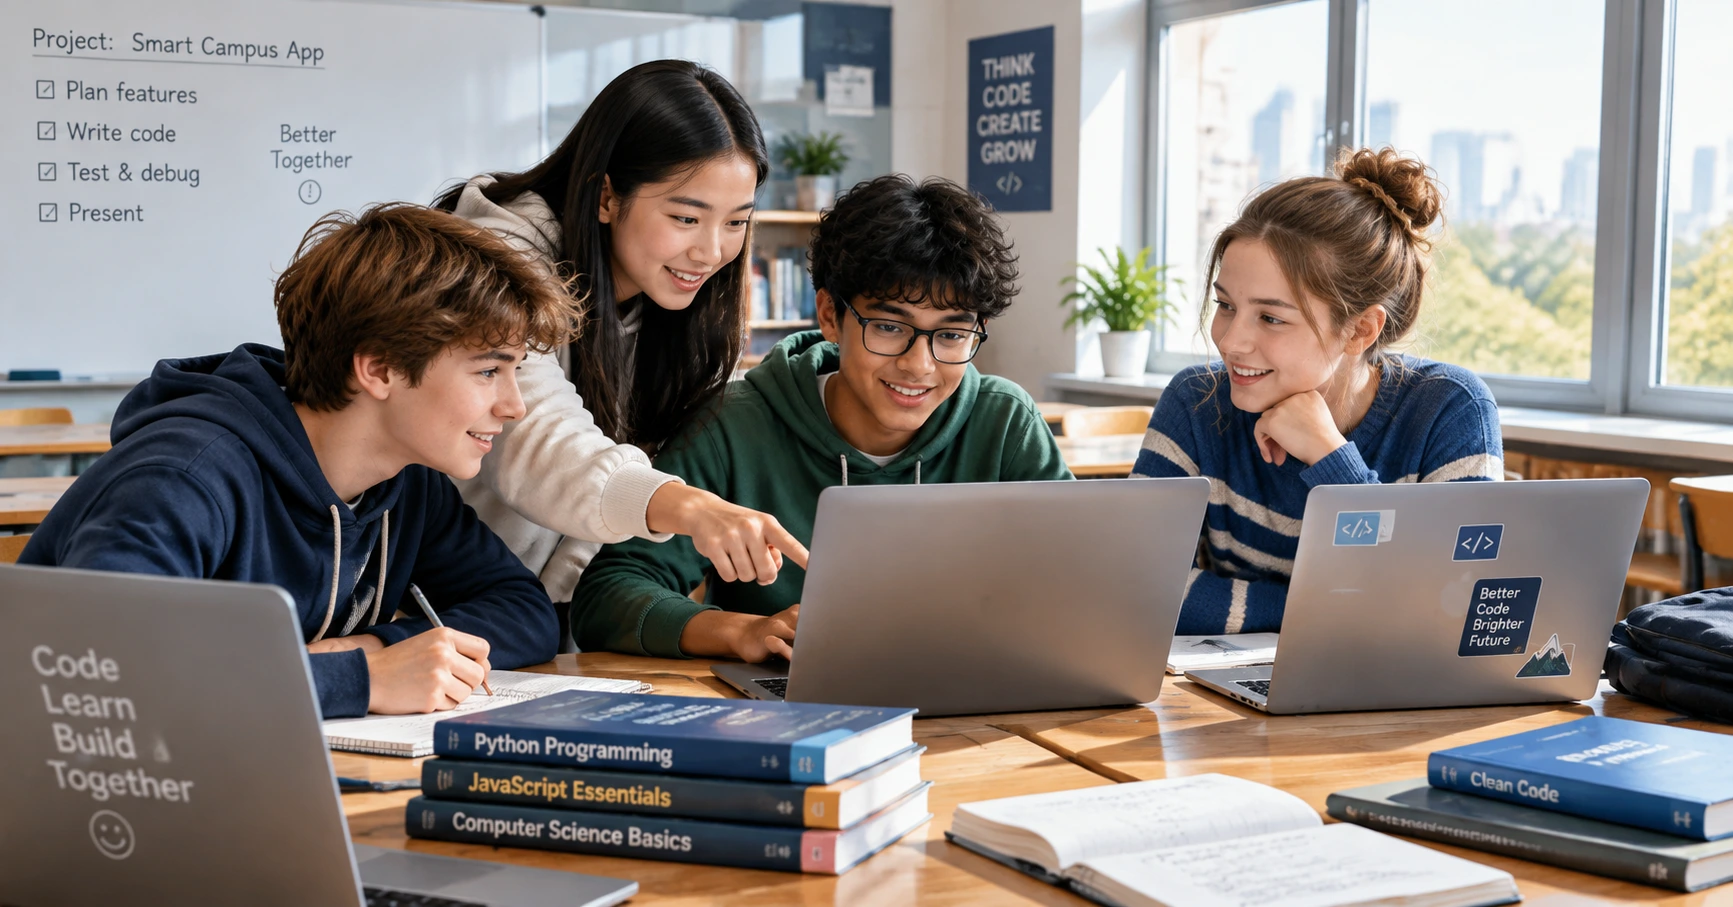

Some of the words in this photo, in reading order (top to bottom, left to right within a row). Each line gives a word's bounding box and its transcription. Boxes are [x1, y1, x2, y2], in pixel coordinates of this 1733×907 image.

[33, 28, 113, 54] Project:
[132, 32, 193, 54] Smart
[202, 37, 278, 63] Campus
[286, 41, 324, 66] App
[982, 52, 1035, 80] THINK
[67, 80, 108, 101] Plan
[117, 82, 197, 103] features
[982, 81, 1032, 109] CODE
[67, 122, 122, 141] Write
[130, 124, 176, 142] code
[280, 124, 336, 143] Better
[976, 109, 1042, 137] CREATE
[270, 149, 353, 174] Together
[981, 139, 1036, 165] GROW
[67, 162, 110, 181] Test
[118, 163, 132, 181] &
[141, 163, 200, 188] debug
[70, 203, 144, 222] Present
[1480, 587, 1520, 600] Better
[1476, 602, 1510, 615] Code
[1473, 618, 1524, 633] Brighter
[1469, 635, 1511, 647] Future
[31, 645, 120, 682] Code
[41, 684, 136, 721] Learn
[52, 722, 137, 760] Build
[474, 732, 540, 756] Python
[545, 737, 673, 769] Programming
[46, 759, 194, 802] Together
[468, 772, 567, 802] JavaScript
[572, 781, 672, 808] Essentials
[1470, 771, 1513, 794] Clean
[1517, 779, 1560, 803] Code
[452, 812, 545, 839] Computer
[549, 820, 623, 846] Science
[628, 827, 692, 852] Basics
